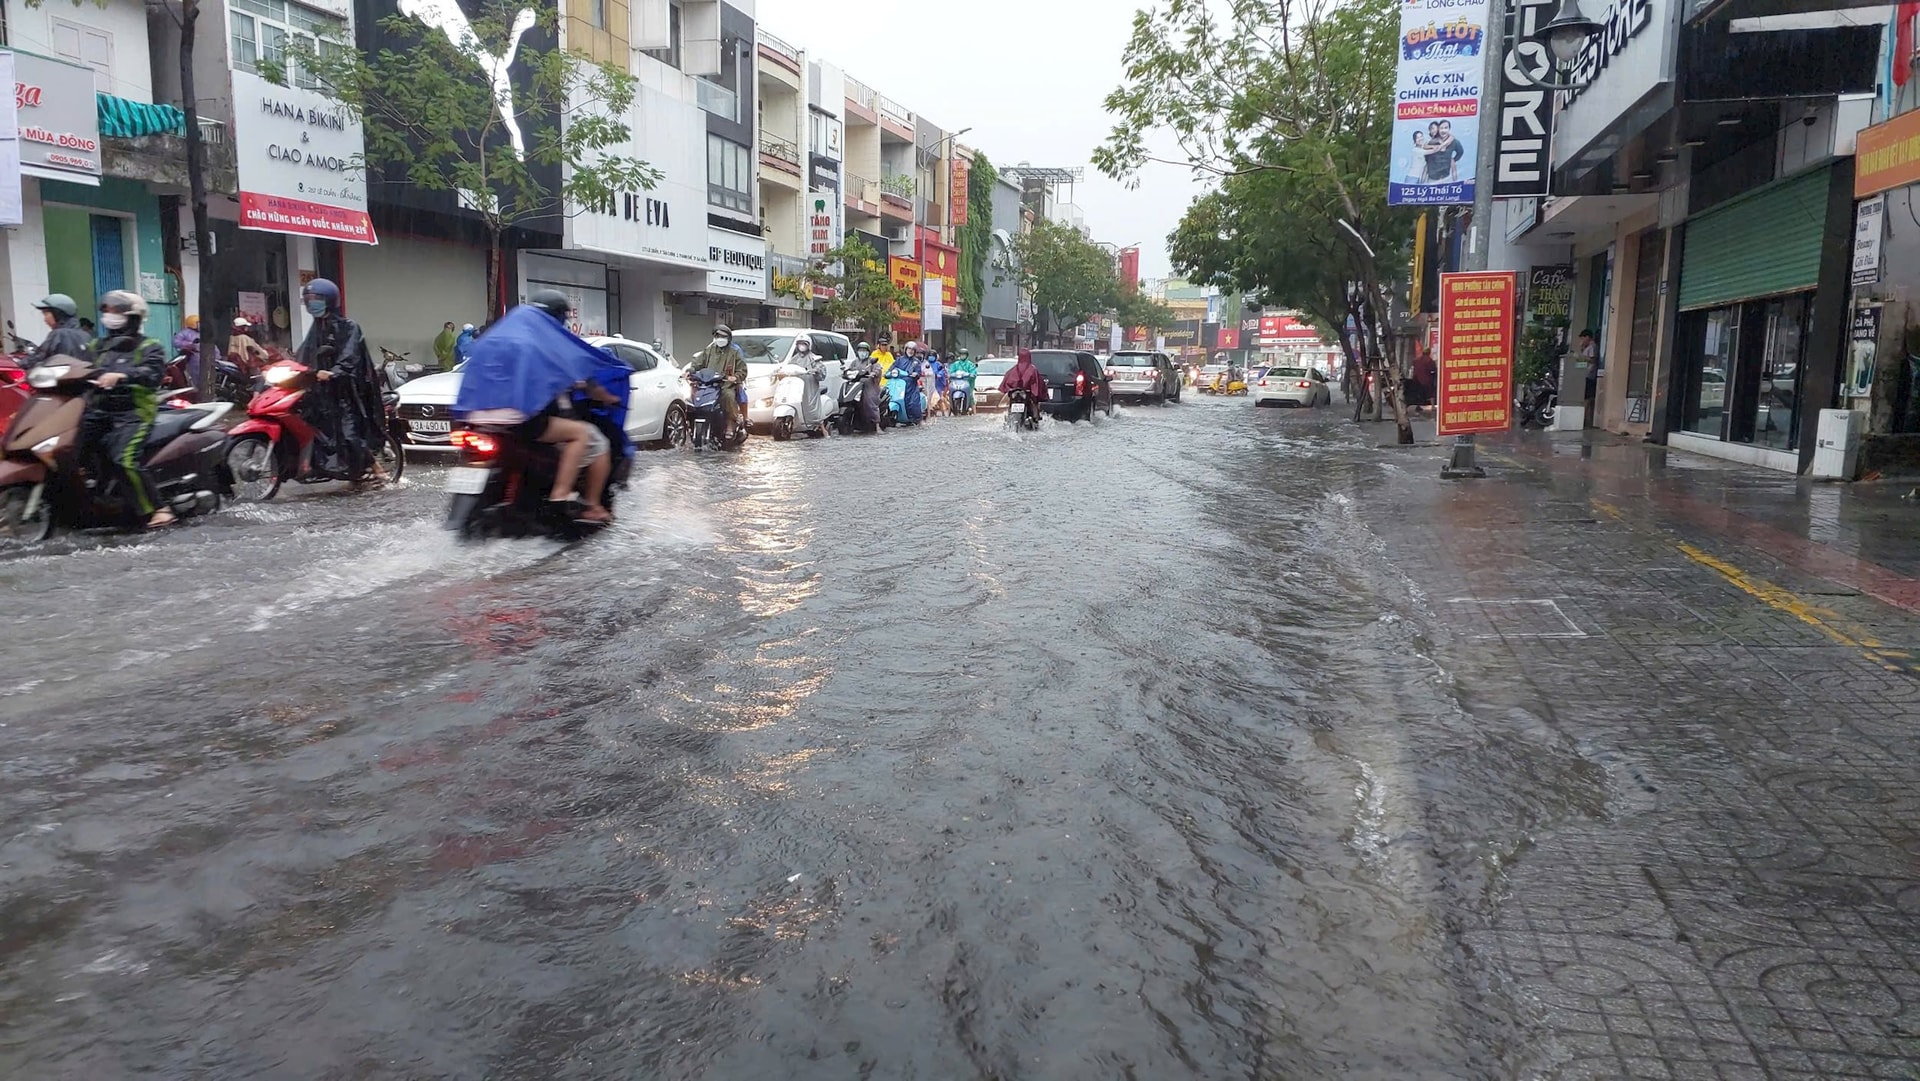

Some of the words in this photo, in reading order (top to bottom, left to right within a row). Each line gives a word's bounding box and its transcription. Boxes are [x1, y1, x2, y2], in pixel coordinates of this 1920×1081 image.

[1406, 20, 1438, 45] GIÁ
[1444, 15, 1481, 40] TỐT
[1414, 72, 1440, 85] VẮC
[1443, 73, 1465, 84] XIN
[1399, 87, 1438, 100] CHÍNH
[1442, 85, 1478, 97] HÃNG
[262, 97, 305, 122] HANA
[308, 109, 345, 131] BIKINI
[1398, 107, 1425, 116] LUÔN
[1426, 103, 1446, 114] SẴN
[1448, 102, 1477, 113] HÀNG
[26, 127, 55, 143] MÙA
[59, 135, 96, 150] ĐÔNG
[301, 131, 310, 143] &
[268, 144, 302, 164] CIAO
[305, 153, 345, 172] AMOR
[1401, 187, 1415, 196] 125
[1417, 187, 1428, 197] Lý
[1429, 185, 1449, 195] Thái
[624, 192, 640, 222] DE
[646, 197, 670, 228] EVA
[247, 208, 267, 221] CHÀO
[268, 211, 290, 224] MỪNG
[291, 214, 311, 227] NGÀY
[312, 216, 331, 230] QUỐC
[812, 230, 829, 241] KIM
[709, 246, 722, 261] HP
[724, 249, 766, 271] BOUTIQUE
[1855, 317, 1863, 327] CÀ
[1854, 329, 1867, 338] ANG
